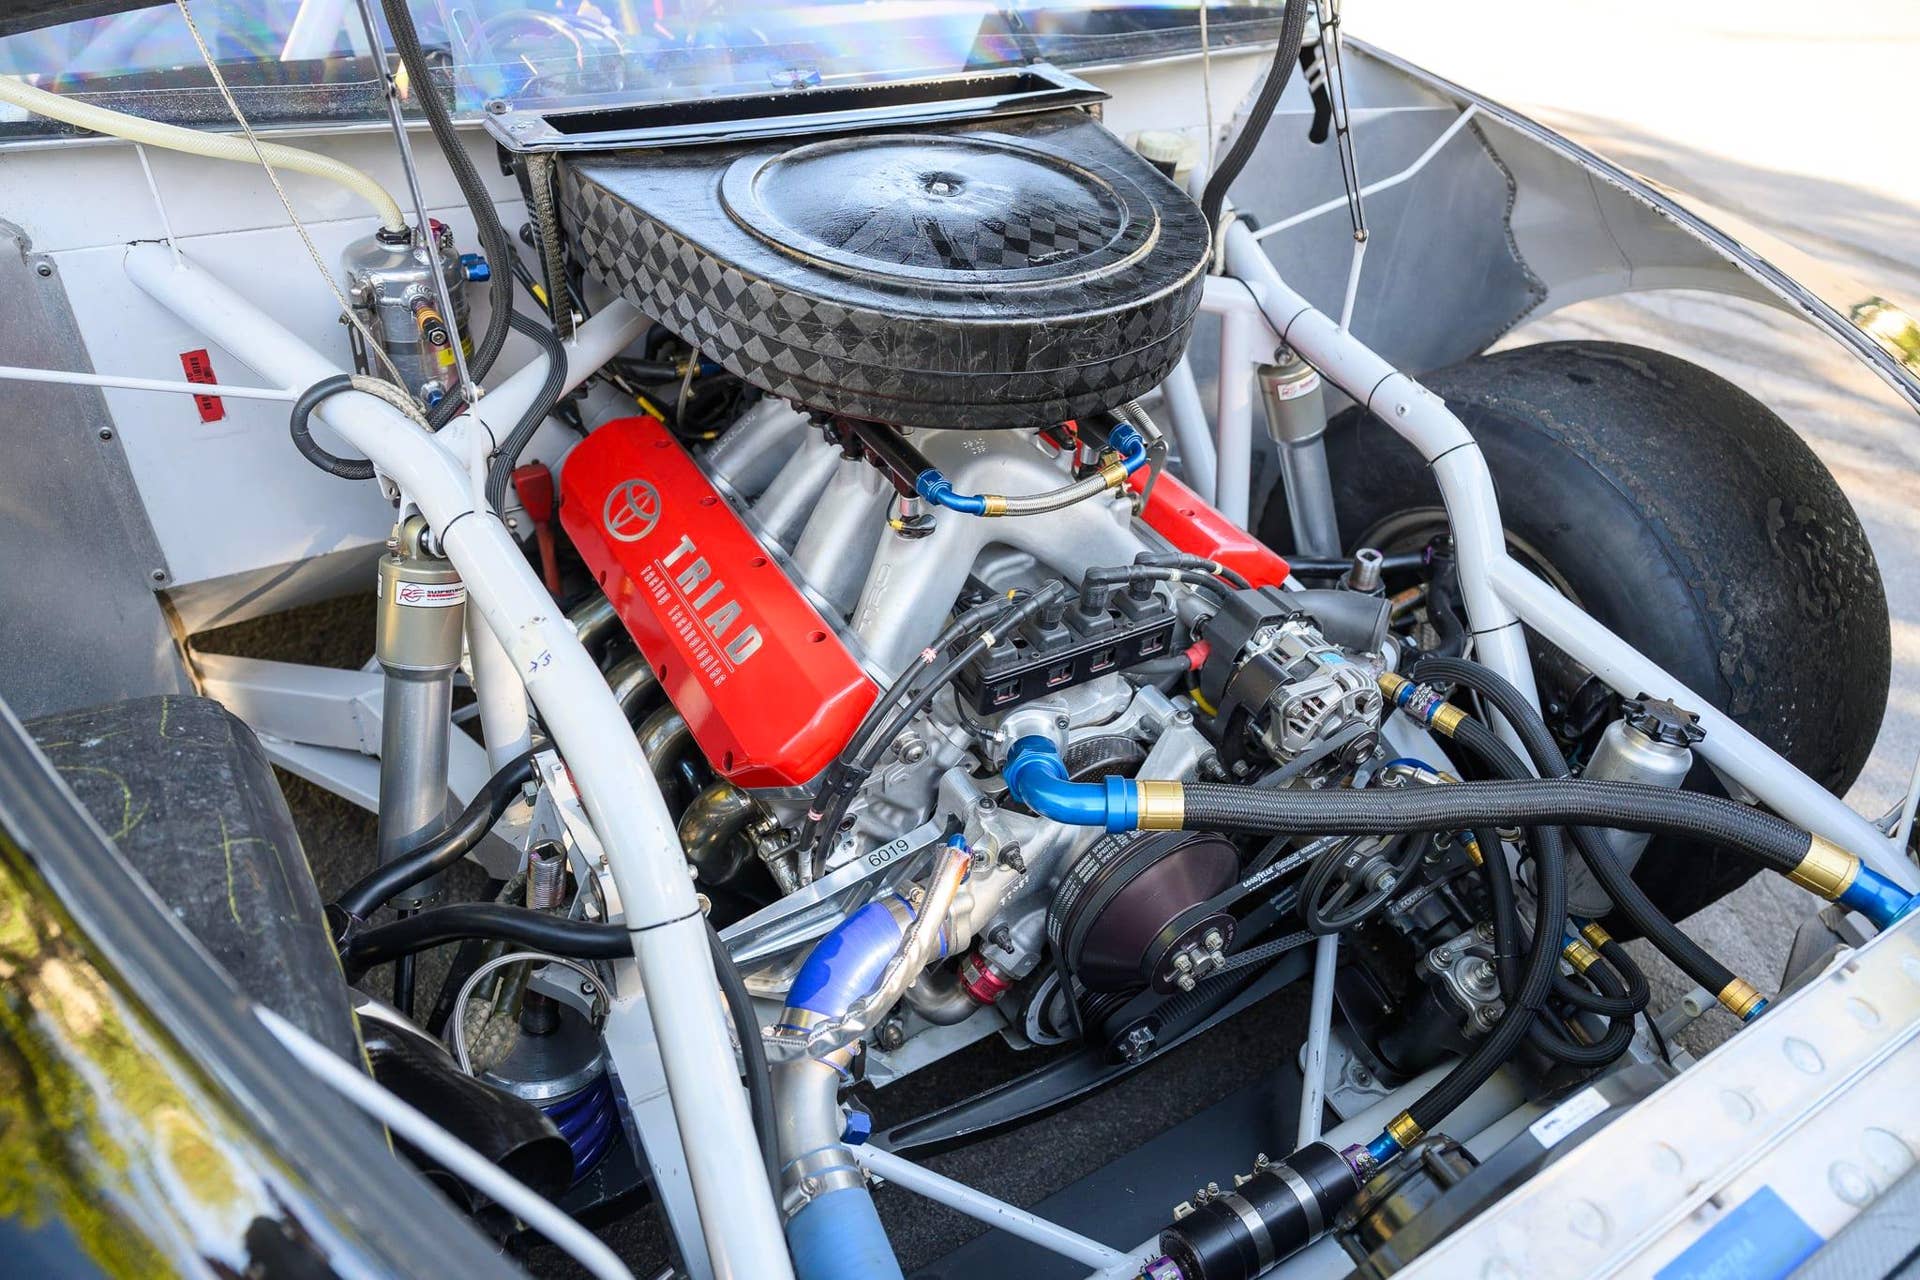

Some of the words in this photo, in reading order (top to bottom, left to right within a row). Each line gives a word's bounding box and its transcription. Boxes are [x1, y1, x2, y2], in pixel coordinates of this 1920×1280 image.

[639, 564, 672, 606] racing
[667, 603, 727, 688] technologies
[662, 533, 764, 666] TRIAD
[868, 839, 909, 867] 6019
